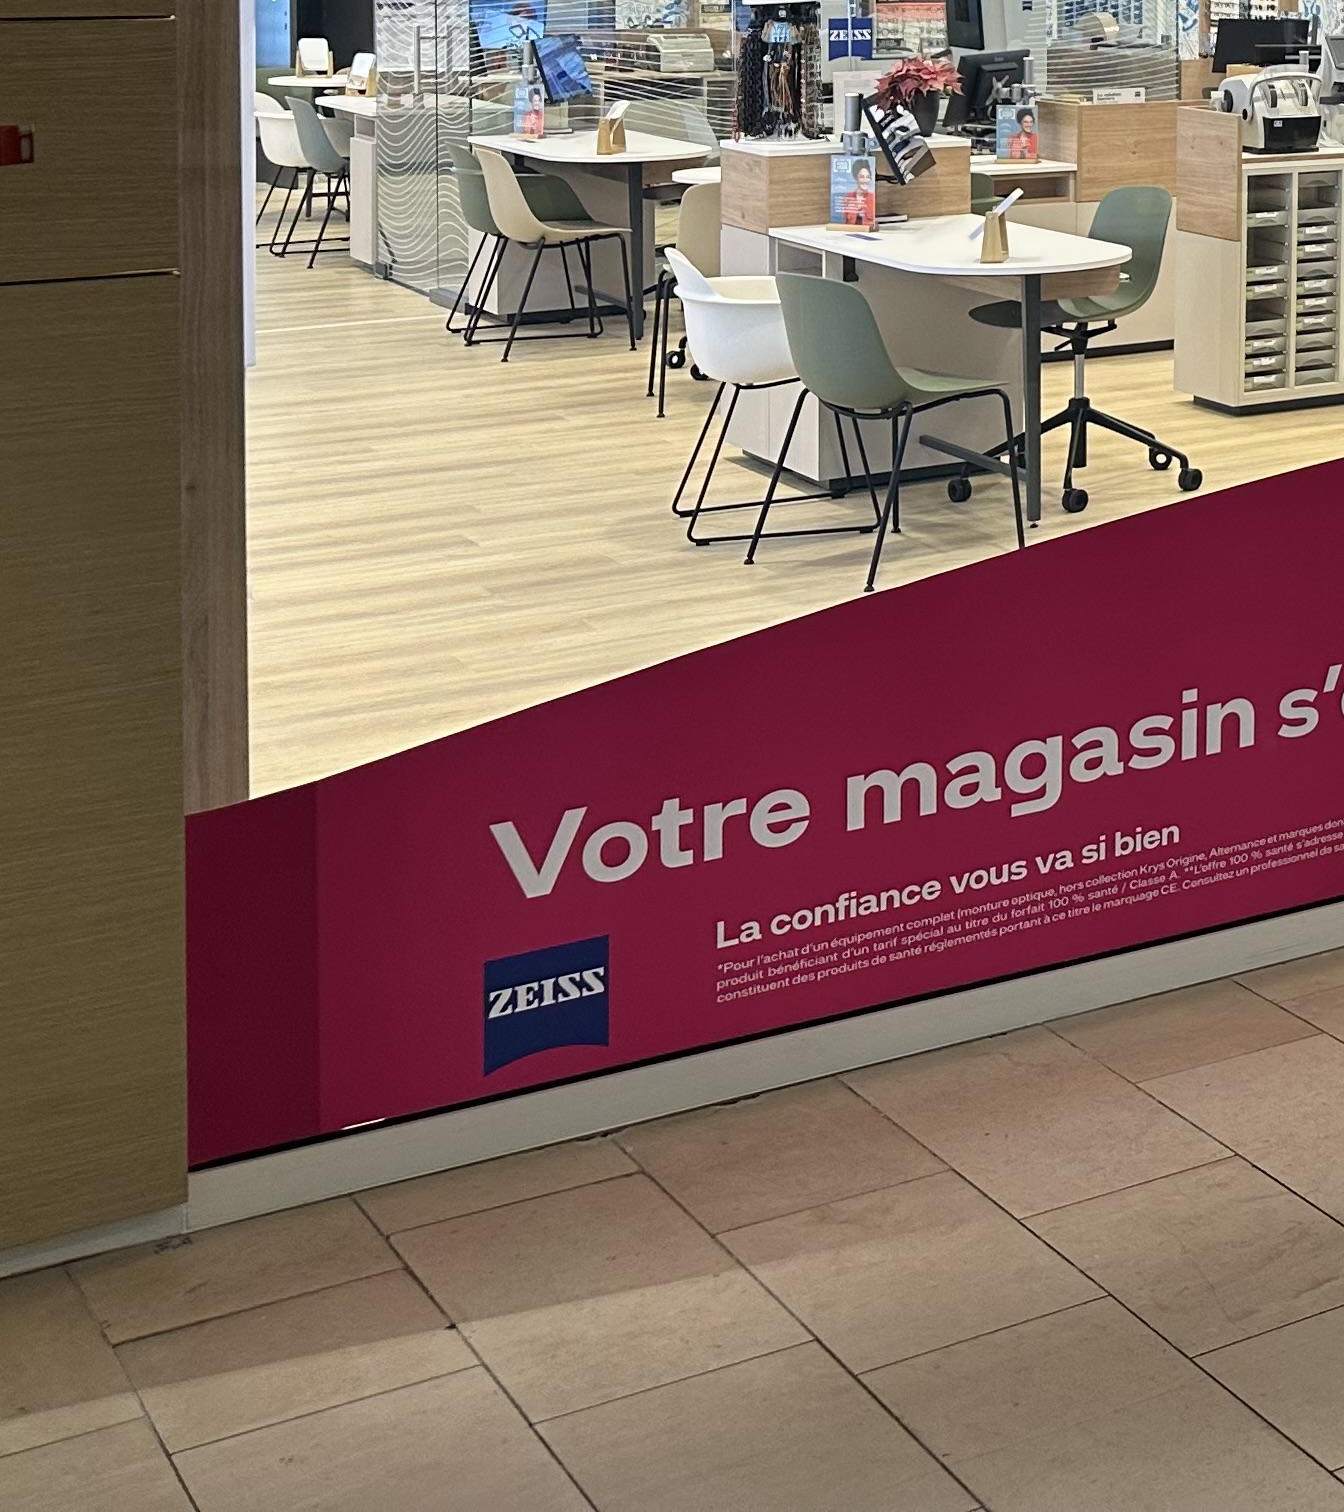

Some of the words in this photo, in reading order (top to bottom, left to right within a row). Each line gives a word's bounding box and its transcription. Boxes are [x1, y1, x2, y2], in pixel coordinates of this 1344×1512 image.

[489, 786, 811, 900] Votre
[844, 688, 1256, 818] magasin
[716, 920, 762, 949] La
[770, 880, 942, 936] confiance
[950, 859, 1028, 895] vous
[1035, 849, 1074, 874] va
[1081, 835, 1106, 865] si
[1114, 825, 1180, 858] bien
[830, 923, 905, 948] équipement
[906, 912, 955, 931] complet
[957, 899, 1009, 920] (monture
[487, 965, 607, 1020] ZEISS
[716, 970, 763, 992] produit
[768, 952, 838, 976] bénéficiant
[873, 937, 898, 952] tarif
[901, 926, 944, 946] spécial
[946, 924, 962, 934] au
[965, 918, 989, 930] titre
[992, 913, 1008, 923] du
[716, 978, 790, 1003] constituent
[792, 973, 816, 984] des
[817, 960, 870, 981] produits
[871, 956, 887, 966] de
[888, 945, 922, 961] santé
[924, 929, 997, 953] réglementés
[999, 917, 1042, 936] portant
